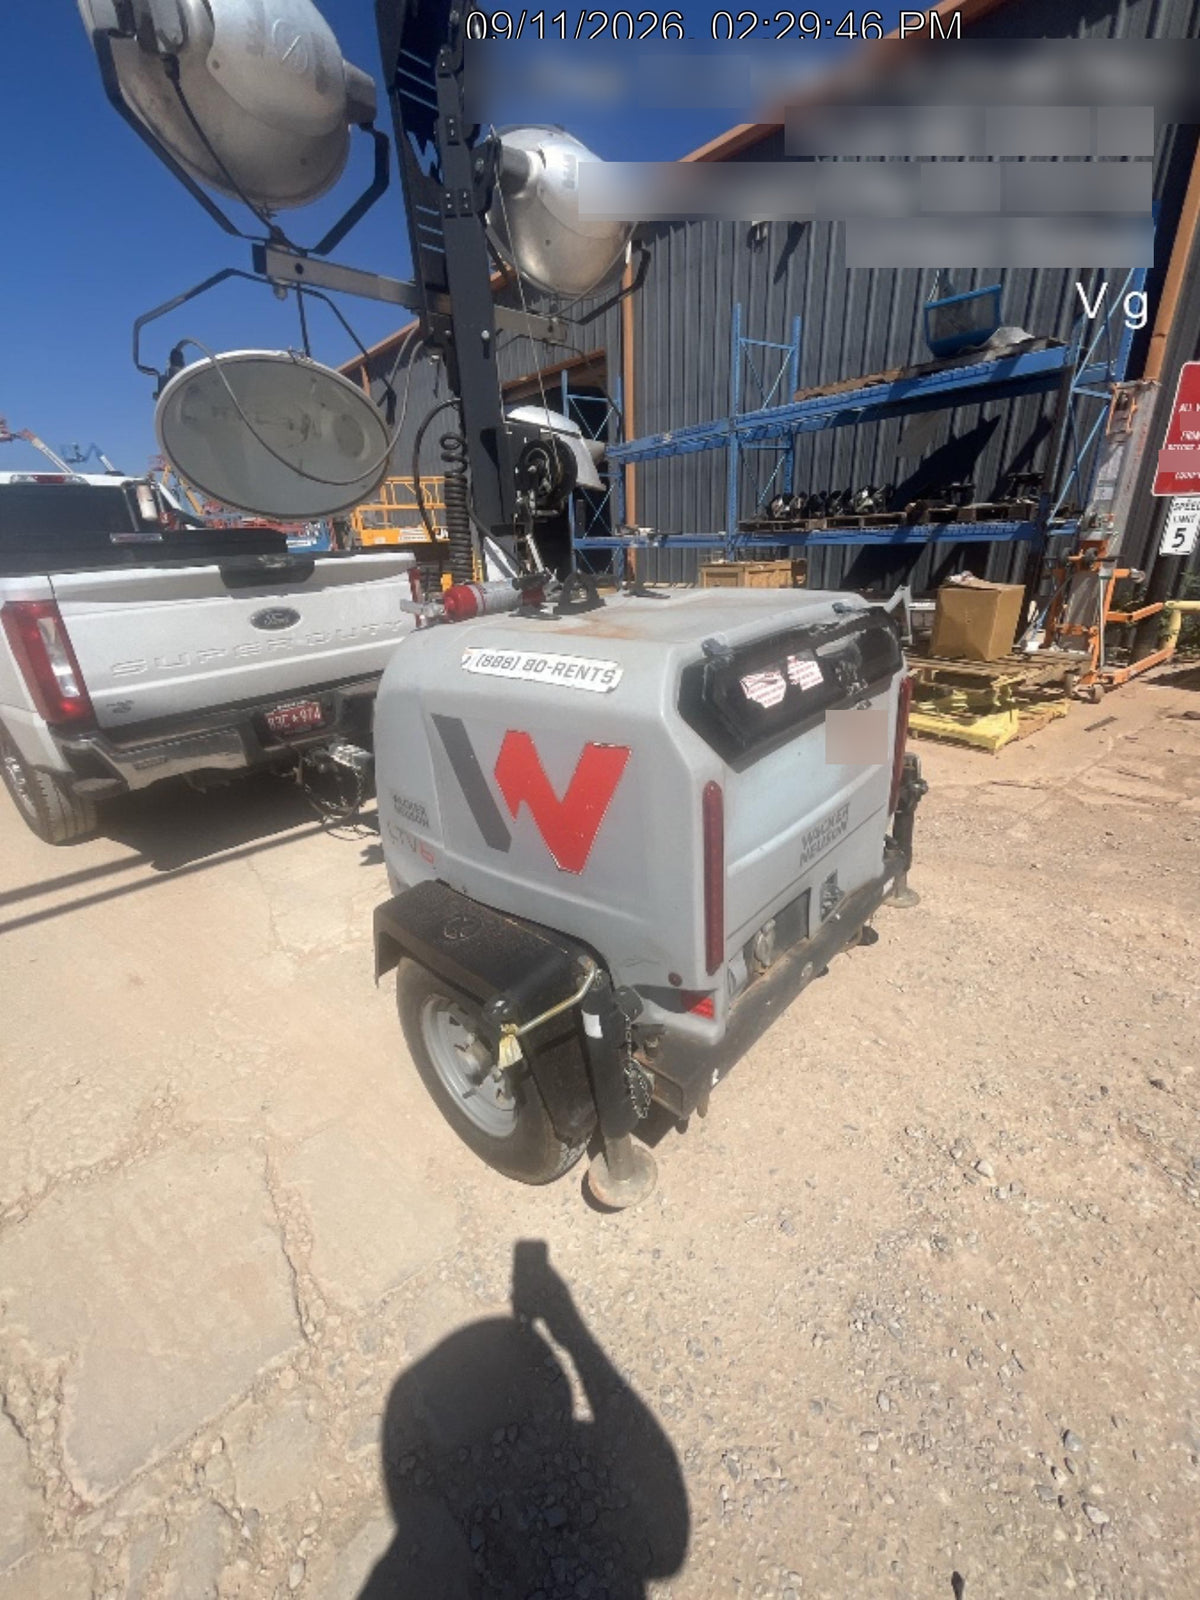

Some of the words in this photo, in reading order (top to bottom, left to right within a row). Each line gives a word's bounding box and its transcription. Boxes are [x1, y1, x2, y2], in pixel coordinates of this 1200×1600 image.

[1171, 527, 1187, 548] 5
[475, 653, 521, 671] (888)
[522, 658, 616, 685] 80-RENTS
